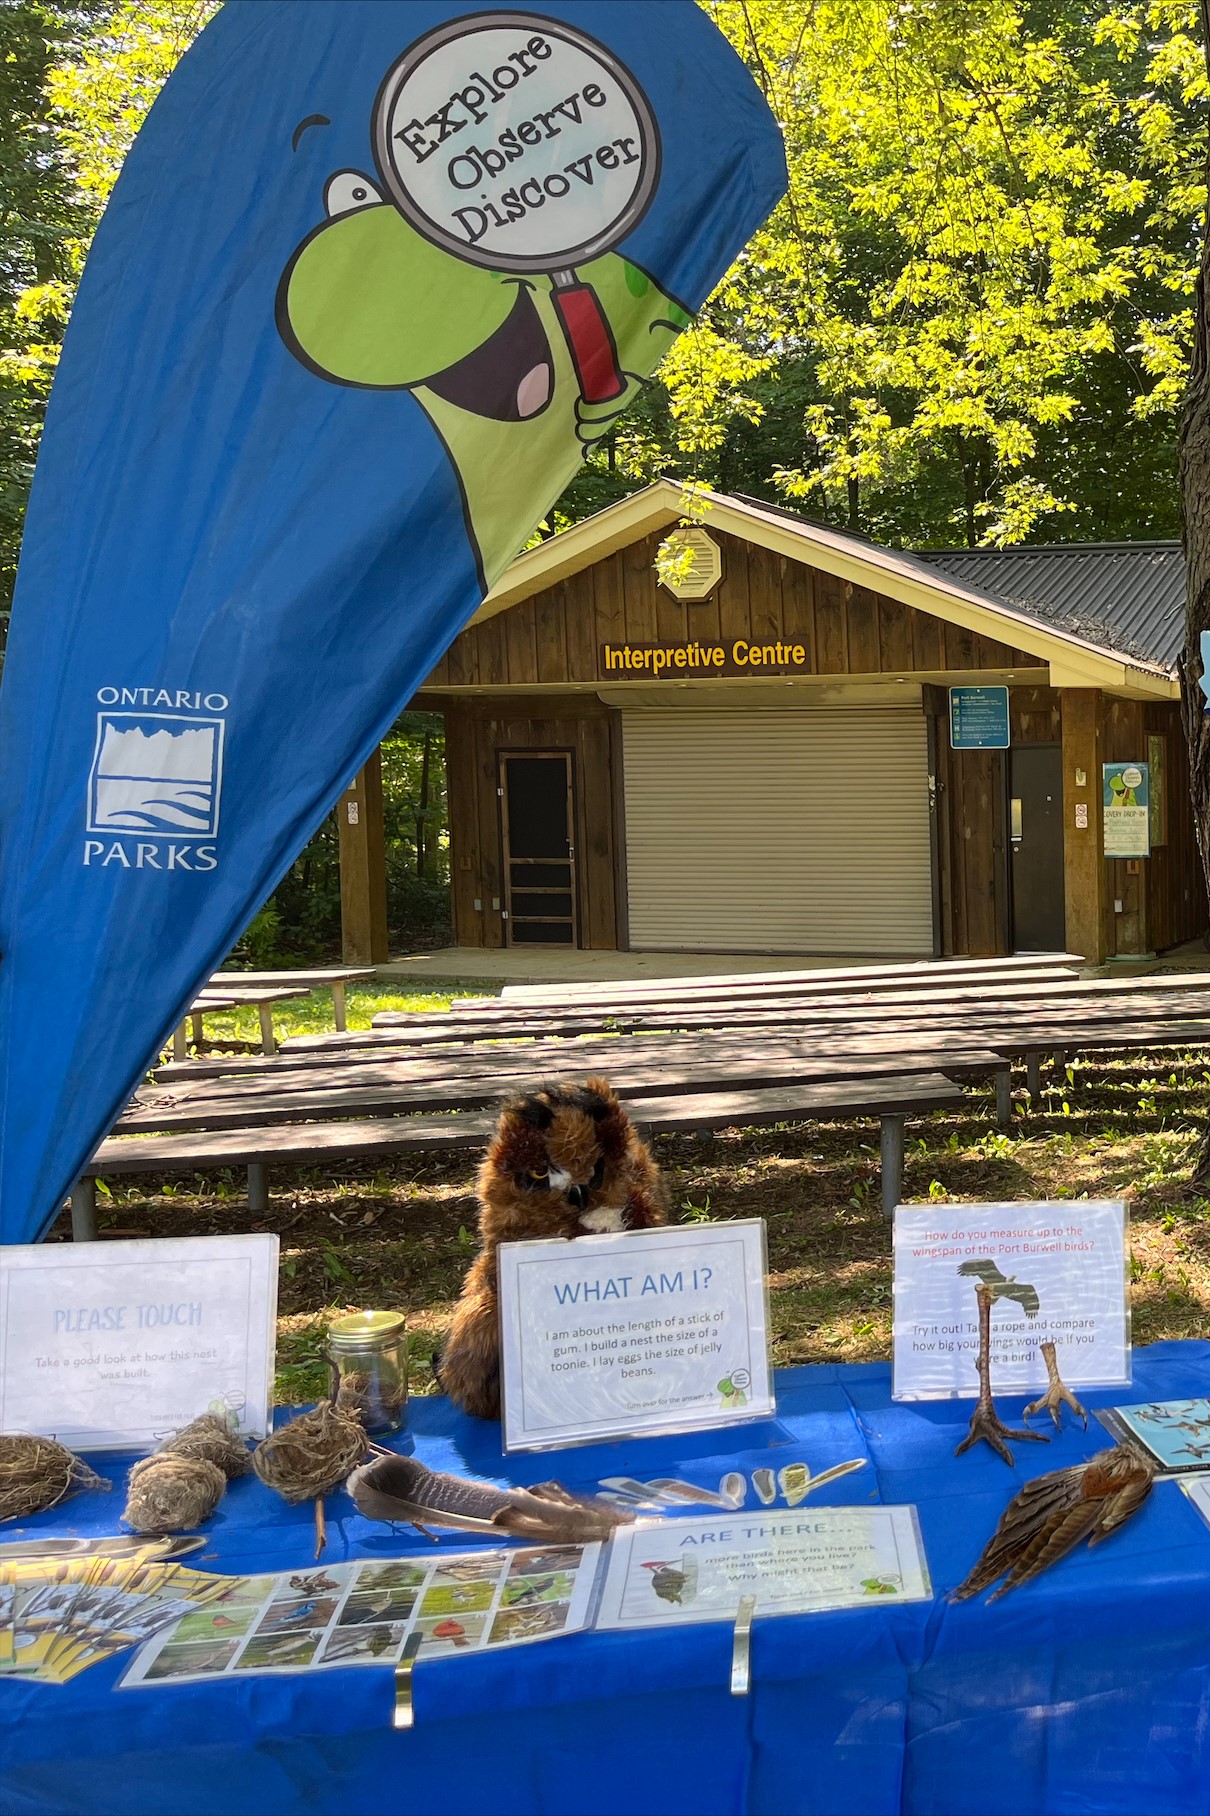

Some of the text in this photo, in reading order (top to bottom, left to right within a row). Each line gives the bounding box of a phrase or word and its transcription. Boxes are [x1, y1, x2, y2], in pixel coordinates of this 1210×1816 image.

[393, 36, 552, 163] Explore
[448, 83, 607, 190] Observe
[452, 136, 639, 243] Discover
[605, 640, 805, 674] Interpretive Centre
[97, 686, 229, 711] ONTARIO
[83, 840, 217, 871] PARKS
[925, 1226, 1083, 1242] How do you measure up to the
[912, 1240, 1095, 1258] wingspan of the Port Burwell birds?
[553, 1267, 713, 1305] WHAT AM I?
[54, 1301, 203, 1333] PLEASE TOUCH
[552, 1331, 569, 1341] am
[572, 1327, 604, 1338] about
[608, 1323, 625, 1334] the
[628, 1318, 662, 1331] length
[664, 1316, 676, 1326] of
[688, 1312, 711, 1324] stick
[714, 1311, 725, 1321] of
[912, 1326, 929, 1336] Try
[932, 1326, 938, 1334] it
[942, 1324, 963, 1334] out!
[992, 1324, 998, 1332] a
[1002, 1323, 1025, 1333] rope
[1028, 1320, 1048, 1330] and
[1050, 1320, 1095, 1331] compare
[554, 1345, 581, 1358] gum.
[591, 1338, 618, 1351] build
[630, 1336, 653, 1346] nest
[656, 1332, 673, 1342] the
[676, 1330, 696, 1341] size
[698, 1328, 710, 1338] of
[712, 1328, 718, 1336] a
[912, 1341, 935, 1351] how
[938, 1340, 954, 1351] big
[1066, 1334, 1074, 1344] if
[1076, 1335, 1095, 1344] you
[36, 1357, 60, 1368] Take
[74, 1355, 100, 1368] good
[104, 1353, 126, 1364] look
[130, 1354, 142, 1362] at
[145, 1352, 166, 1362] how
[169, 1350, 190, 1360] this
[194, 1348, 217, 1359] nest
[551, 1360, 590, 1372] toonie.
[600, 1356, 614, 1367] lay
[618, 1354, 642, 1364] eggs
[644, 1350, 662, 1360] the
[666, 1346, 684, 1358] size
[688, 1344, 699, 1355] of
[700, 1342, 722, 1355] jelly
[1012, 1352, 1036, 1362] bird!
[101, 1370, 120, 1380] was
[622, 1367, 656, 1378] beans.
[679, 1523, 852, 1547] ARE THERE...
[705, 1554, 739, 1564] more
[743, 1550, 773, 1560] birds
[778, 1548, 806, 1556] here
[824, 1544, 845, 1552] the
[849, 1544, 876, 1552] park
[726, 1552, 858, 1570] than where you live?
